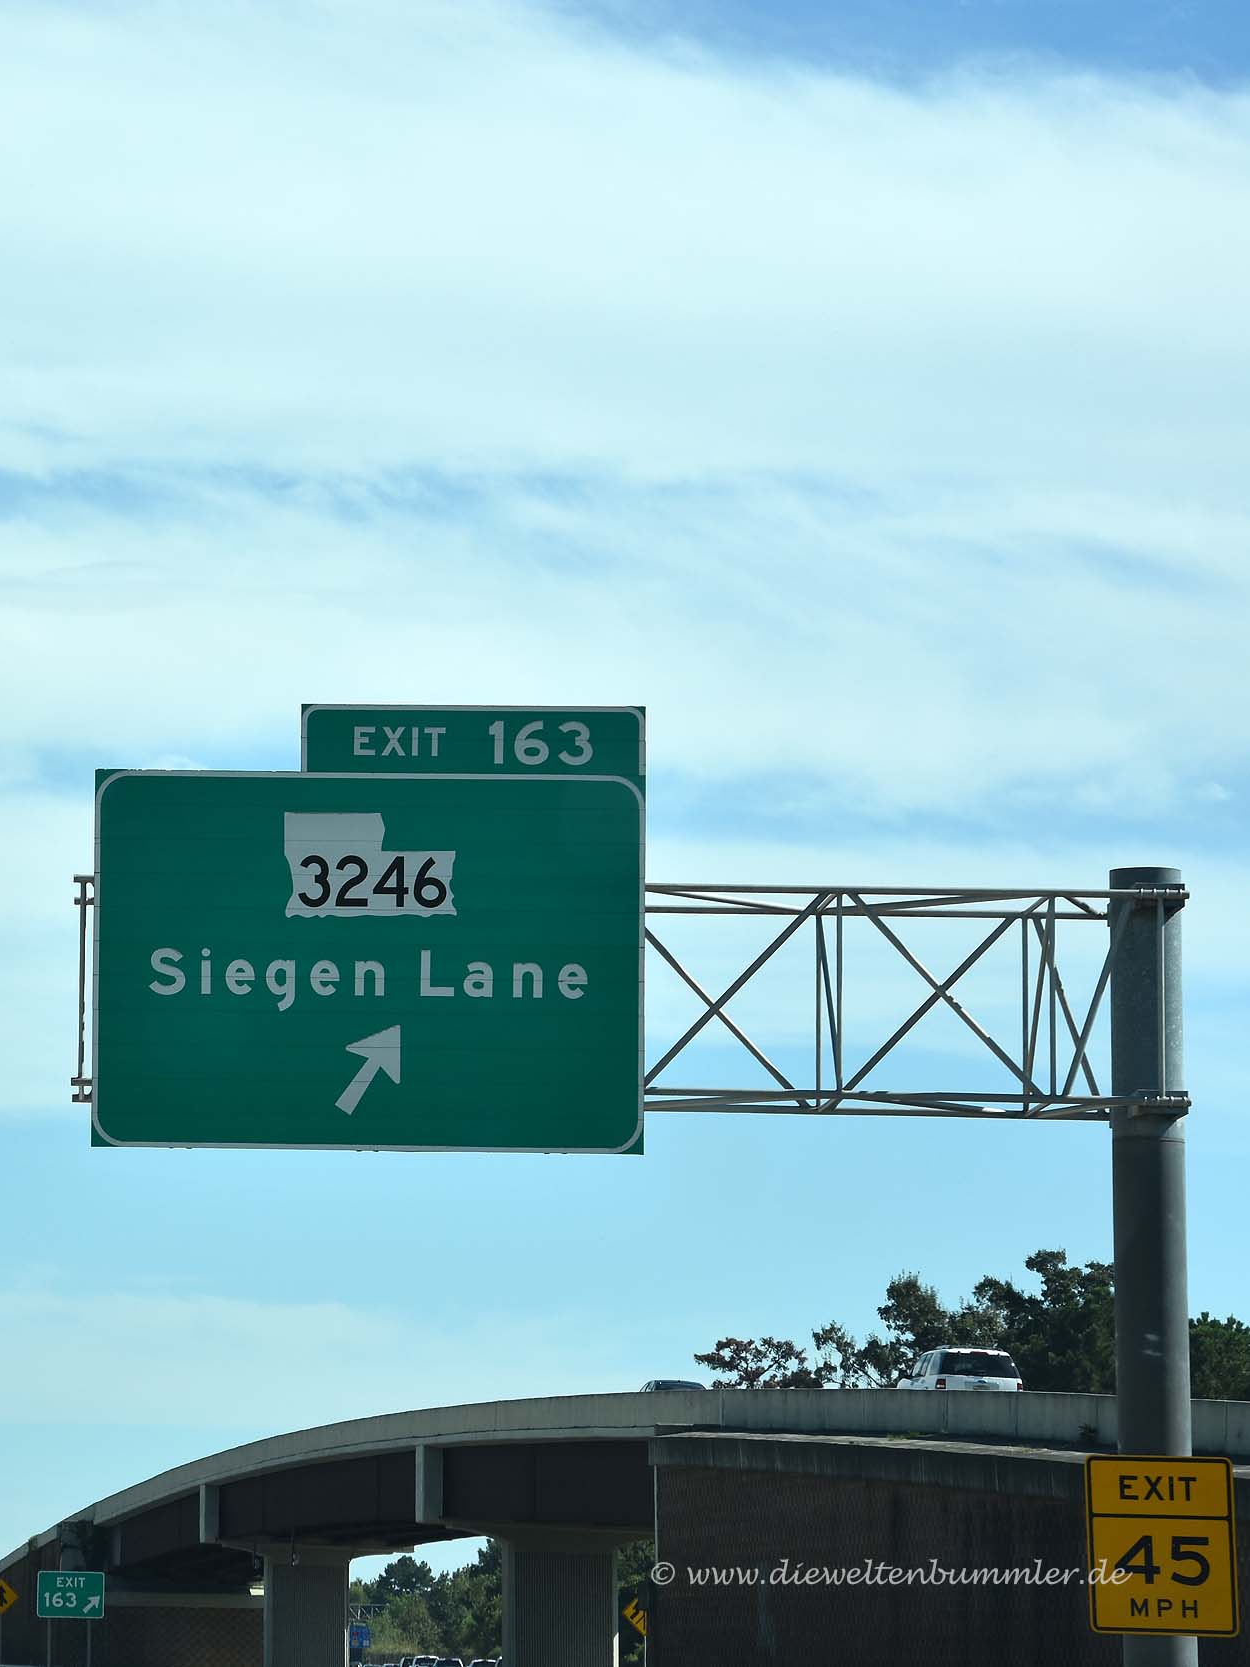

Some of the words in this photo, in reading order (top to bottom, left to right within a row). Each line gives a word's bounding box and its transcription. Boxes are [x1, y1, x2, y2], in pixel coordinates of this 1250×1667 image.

[353, 727, 446, 756] EXIT
[488, 720, 593, 765] 163
[298, 855, 447, 908] 3246
[149, 948, 385, 1011] Siegen
[420, 950, 588, 999] Lane
[1119, 1475, 1197, 1501] EXIT
[1114, 1535, 1210, 1586] 45
[44, 1592, 77, 1607] 163
[56, 1577, 85, 1588] EXIT
[1130, 1598, 1198, 1618] MPH
